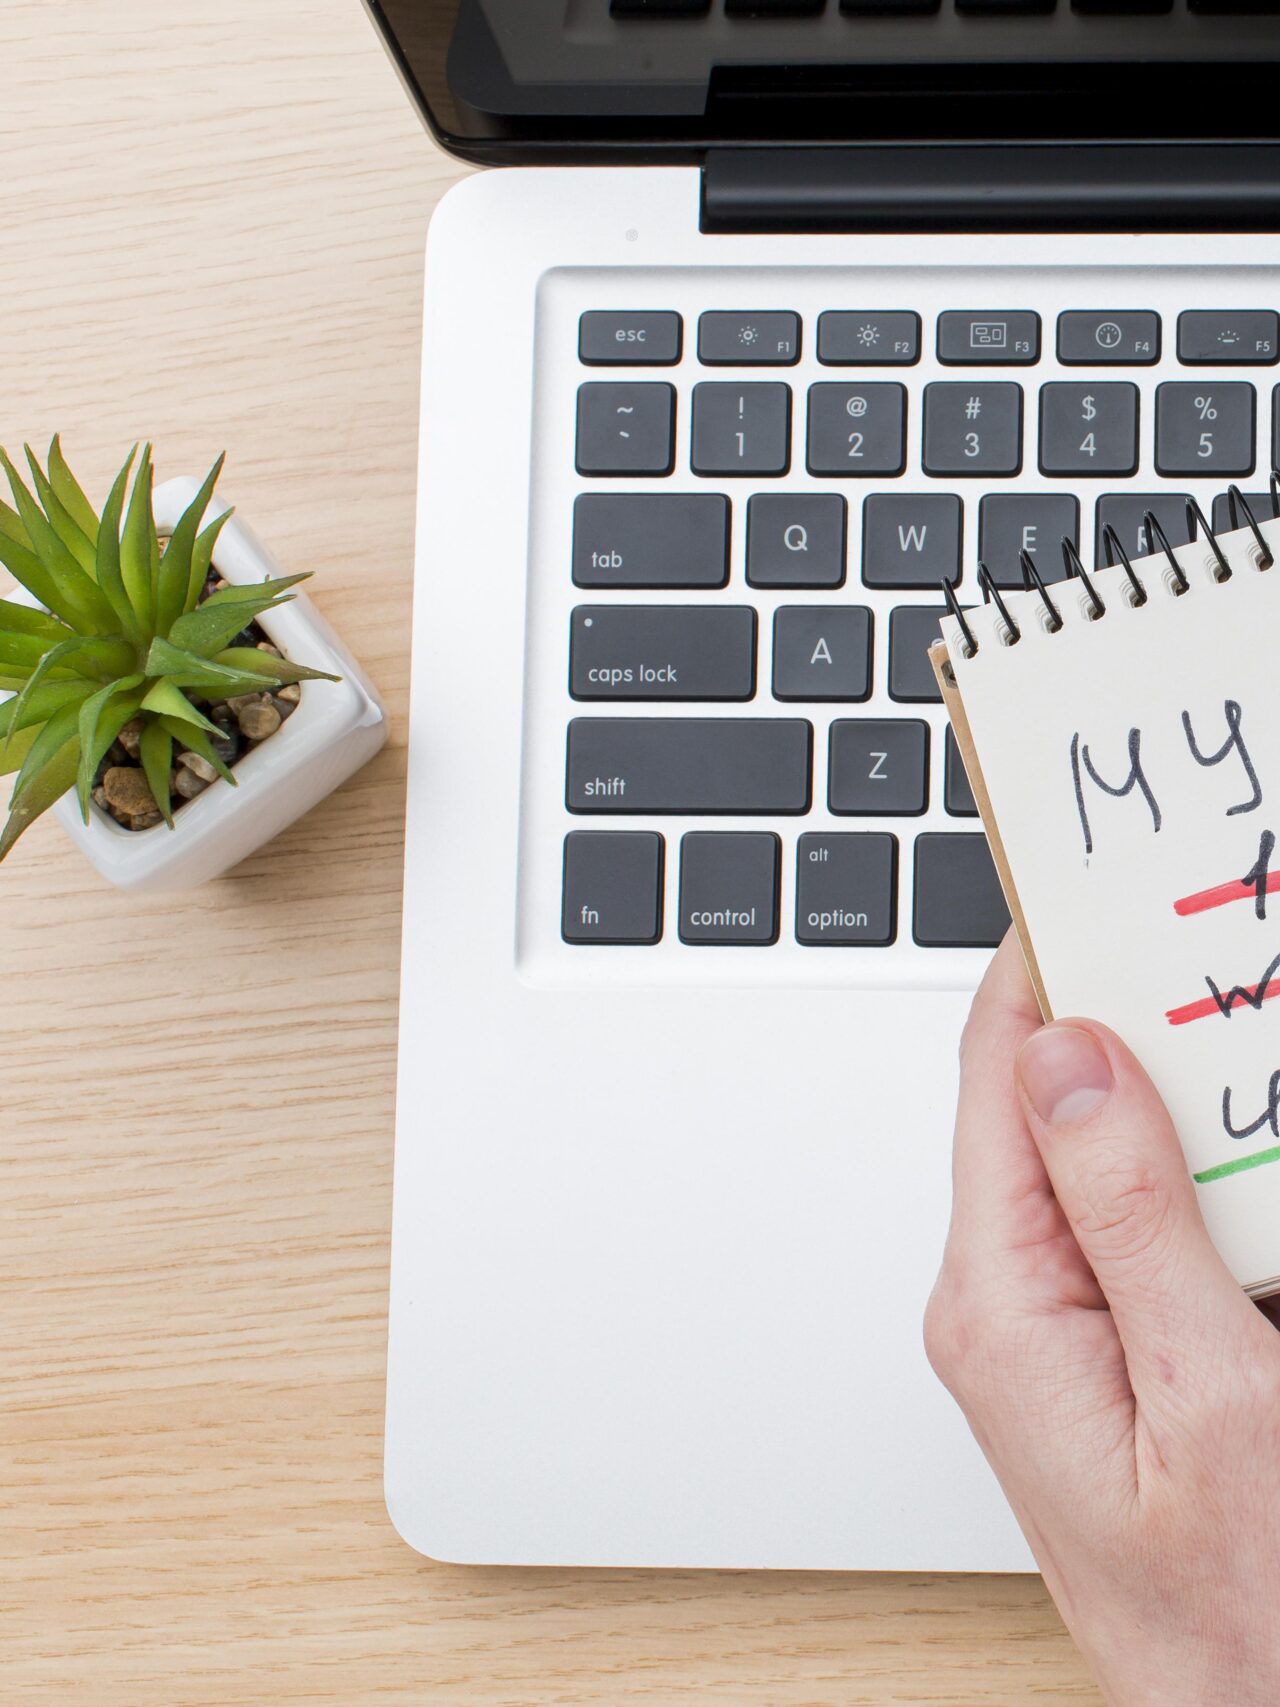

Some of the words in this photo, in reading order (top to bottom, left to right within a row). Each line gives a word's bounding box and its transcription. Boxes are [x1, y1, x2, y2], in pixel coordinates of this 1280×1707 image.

[615, 329, 646, 342] esc
[777, 341, 790, 353] F1
[894, 341, 910, 353] F2
[1015, 341, 1030, 353] F3
[1135, 341, 1150, 353] F4
[1255, 340, 1271, 352] F5
[738, 396, 744, 420] !
[846, 396, 868, 418] @
[965, 396, 982, 420] #
[1081, 395, 1097, 421] $
[1194, 396, 1218, 420] %
[735, 432, 744, 457] 1
[848, 432, 864, 457] 2
[964, 432, 980, 457] 3
[1079, 432, 1097, 457] 4
[1197, 432, 1213, 458] 5
[783, 524, 808, 551] Q
[898, 525, 927, 552] W
[1022, 525, 1038, 553] E
[591, 550, 623, 568] tab
[810, 637, 833, 665] A
[588, 668, 633, 686] caps
[639, 664, 677, 682] lock
[868, 752, 888, 779] Z
[584, 777, 626, 796] shift
[1070, 699, 1263, 864] My
[809, 847, 829, 862] alt
[580, 905, 599, 924] fn
[690, 907, 755, 926] control
[807, 909, 868, 931] option
